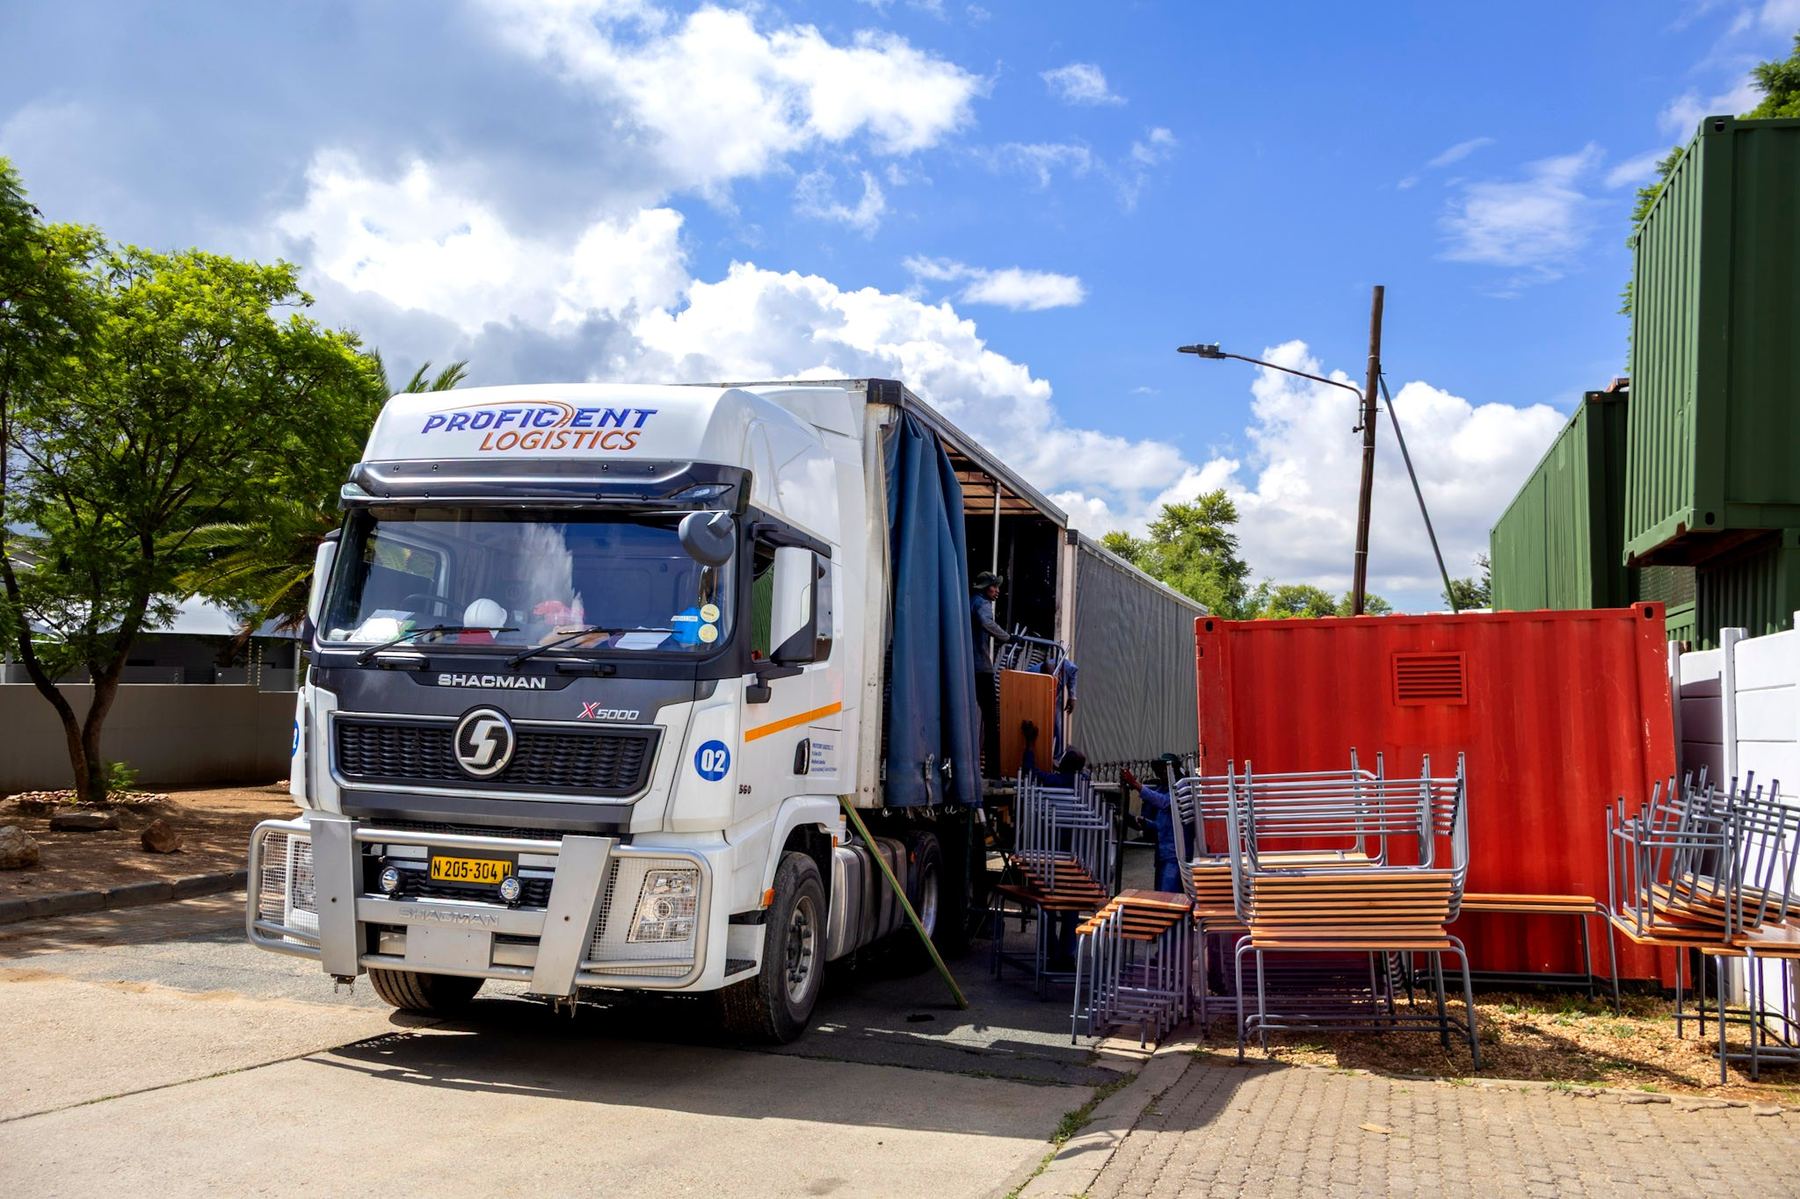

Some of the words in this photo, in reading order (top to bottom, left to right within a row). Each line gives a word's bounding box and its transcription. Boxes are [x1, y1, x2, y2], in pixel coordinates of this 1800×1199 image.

[479, 430, 641, 451] LOGISTICS
[438, 673, 546, 690] SHACMAN
[577, 701, 640, 721] X5000
[701, 748, 726, 773] 02
[433, 859, 441, 877] N
[444, 860, 498, 880] 205-304
[400, 908, 500, 927] SHACMAN
